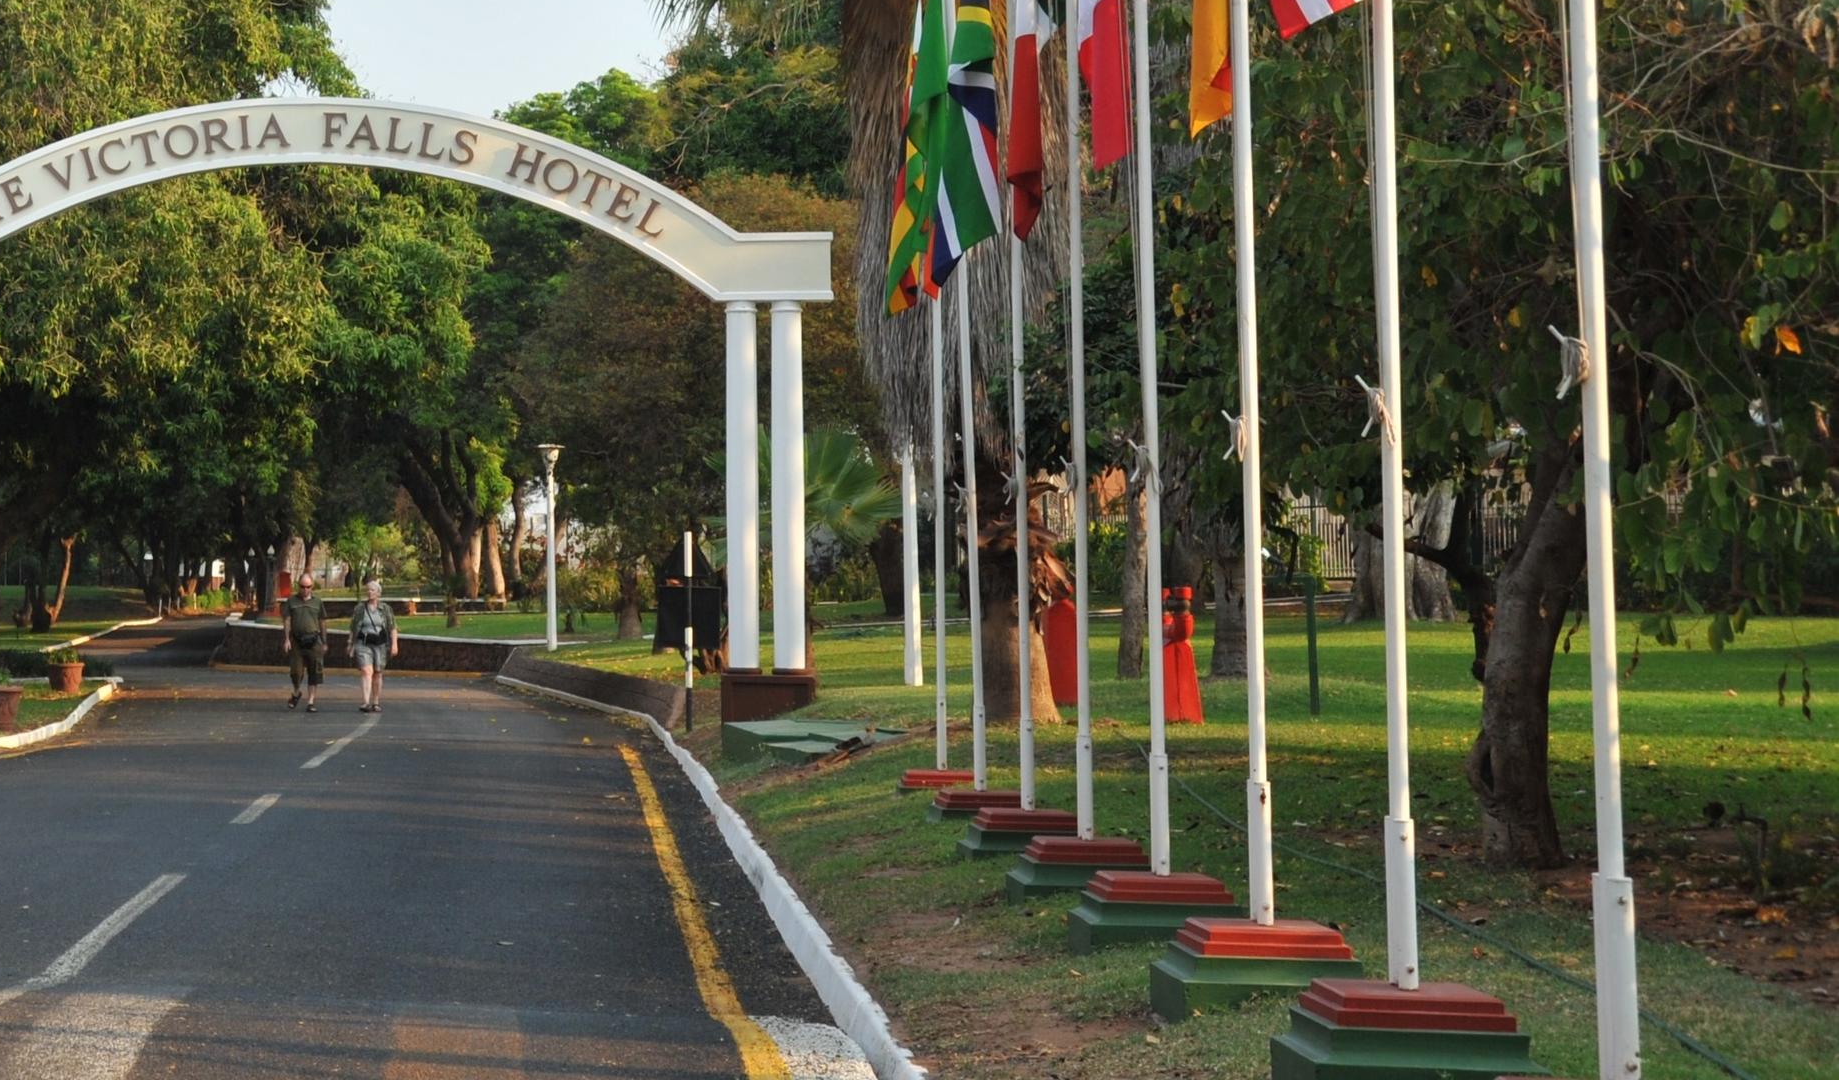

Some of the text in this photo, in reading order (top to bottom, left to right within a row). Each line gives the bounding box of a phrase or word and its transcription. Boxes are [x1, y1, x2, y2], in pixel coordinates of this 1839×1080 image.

[42, 113, 292, 191] VICTORIA
[321, 112, 478, 164] FALLS
[506, 142, 665, 238] HOTEL
